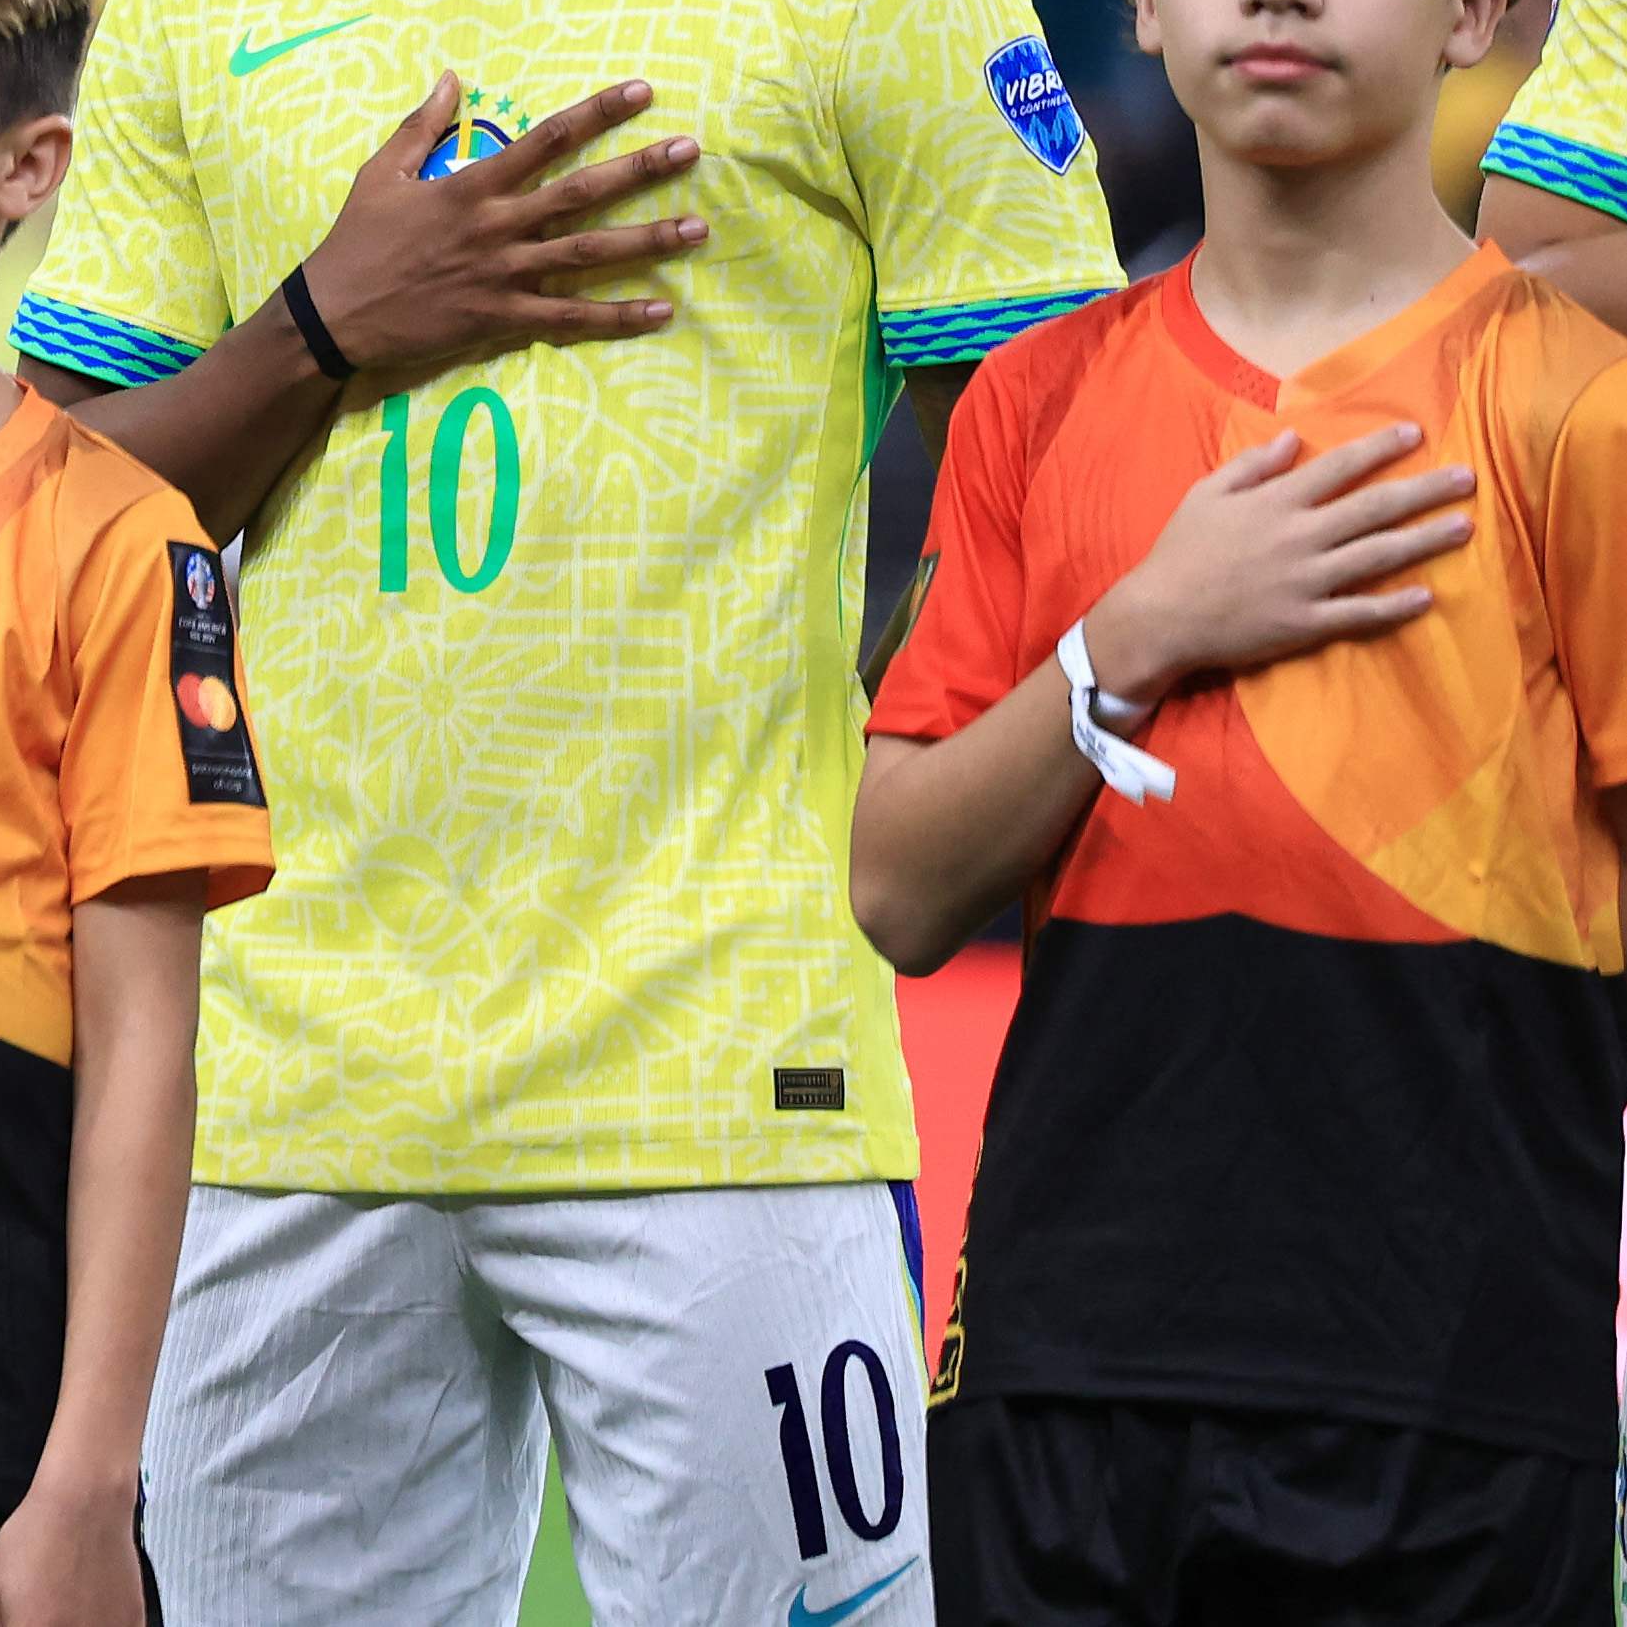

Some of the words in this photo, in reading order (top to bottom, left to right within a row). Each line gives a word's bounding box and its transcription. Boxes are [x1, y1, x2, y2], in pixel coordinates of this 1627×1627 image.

[1010, 108, 1017, 119] O
[379, 386, 521, 594] 10
[764, 1339, 904, 1561] 10
